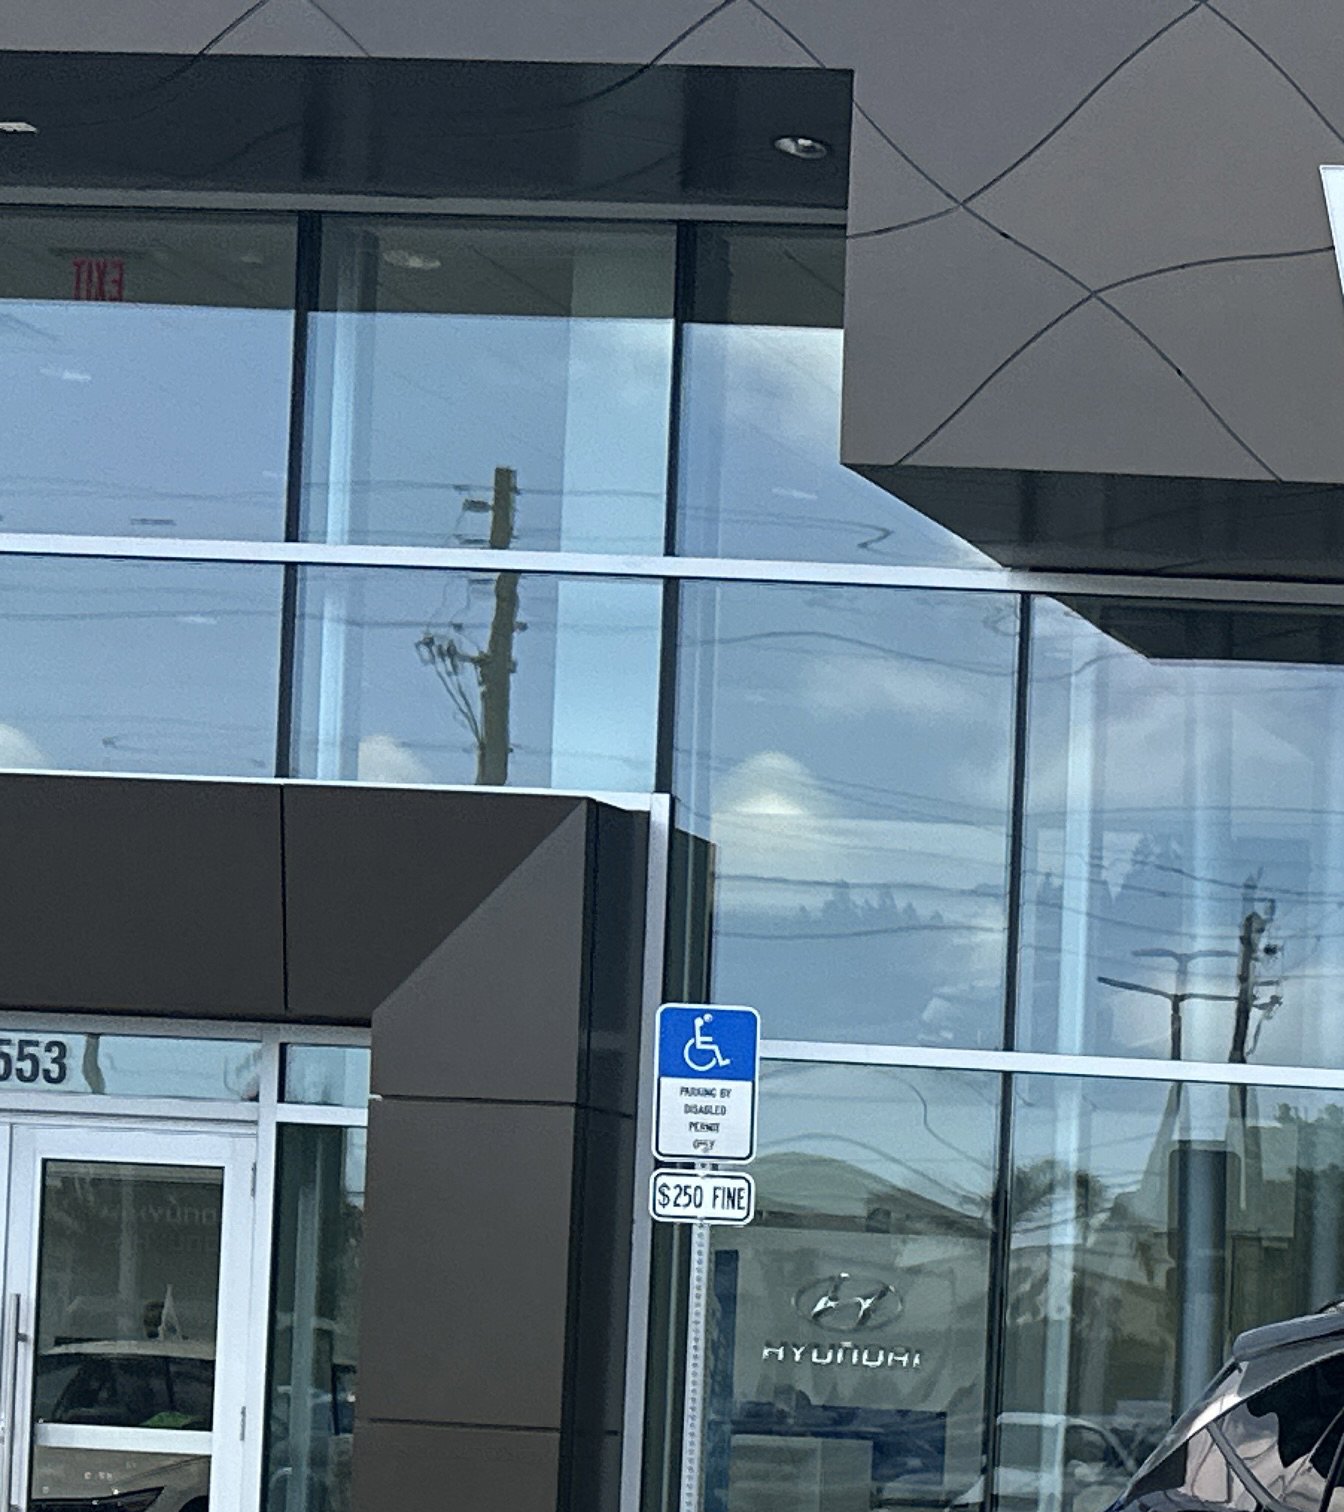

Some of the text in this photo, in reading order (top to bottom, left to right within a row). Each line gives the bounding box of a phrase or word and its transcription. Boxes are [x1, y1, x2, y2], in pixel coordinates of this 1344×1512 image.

[679, 1085, 733, 1099] PARKING BY
[683, 1103, 727, 1116] DISABLED
[657, 1181, 746, 1211] $250 FINE
